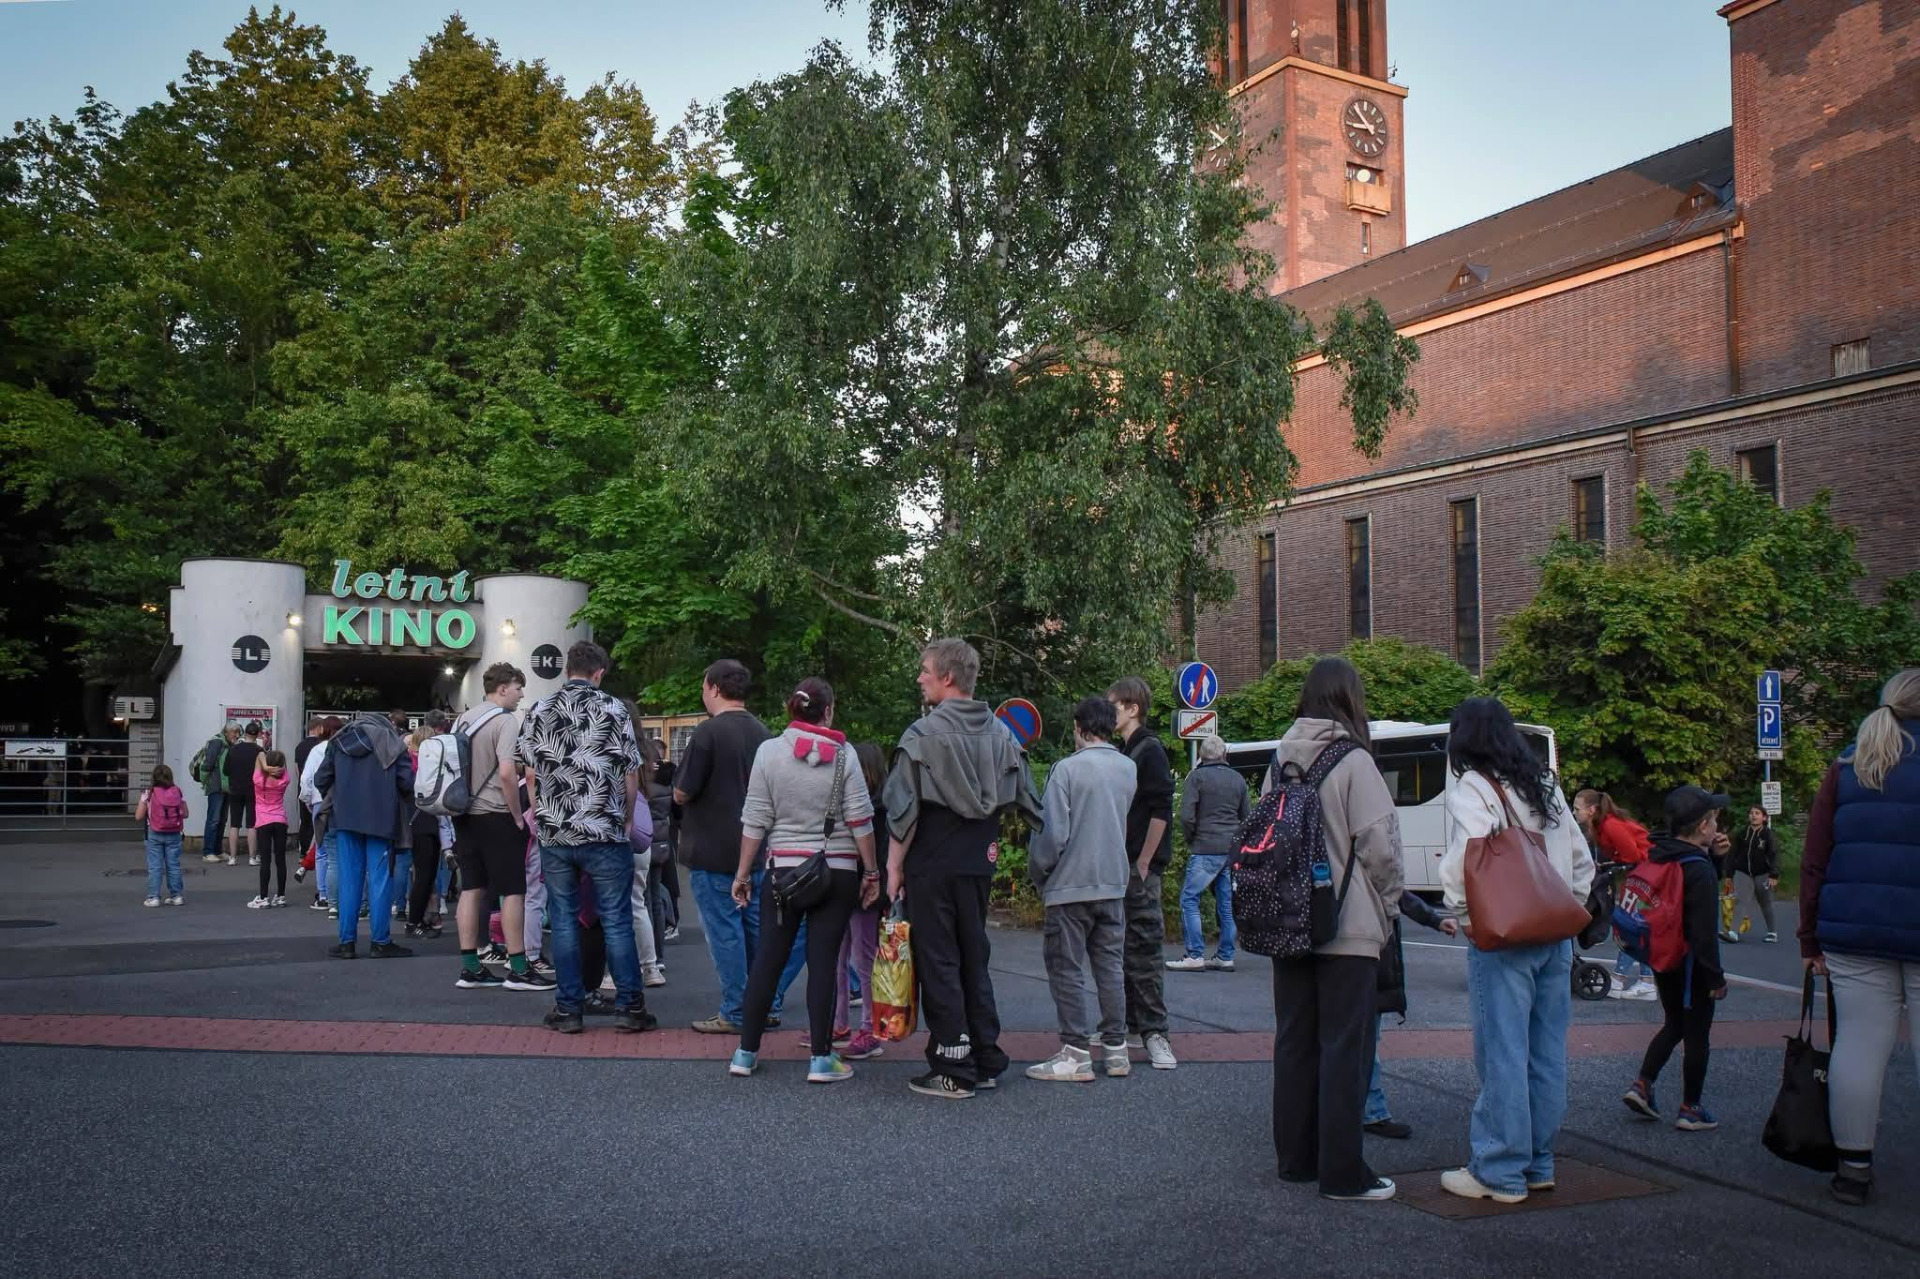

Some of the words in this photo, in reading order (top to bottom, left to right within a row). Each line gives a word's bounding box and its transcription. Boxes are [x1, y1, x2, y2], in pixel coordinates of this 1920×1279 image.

[331, 559, 471, 602] letní
[323, 605, 476, 649] KINO
[246, 648, 258, 660] L
[542, 656, 553, 668] K
[130, 702, 139, 713] L
[1764, 707, 1775, 733] P
